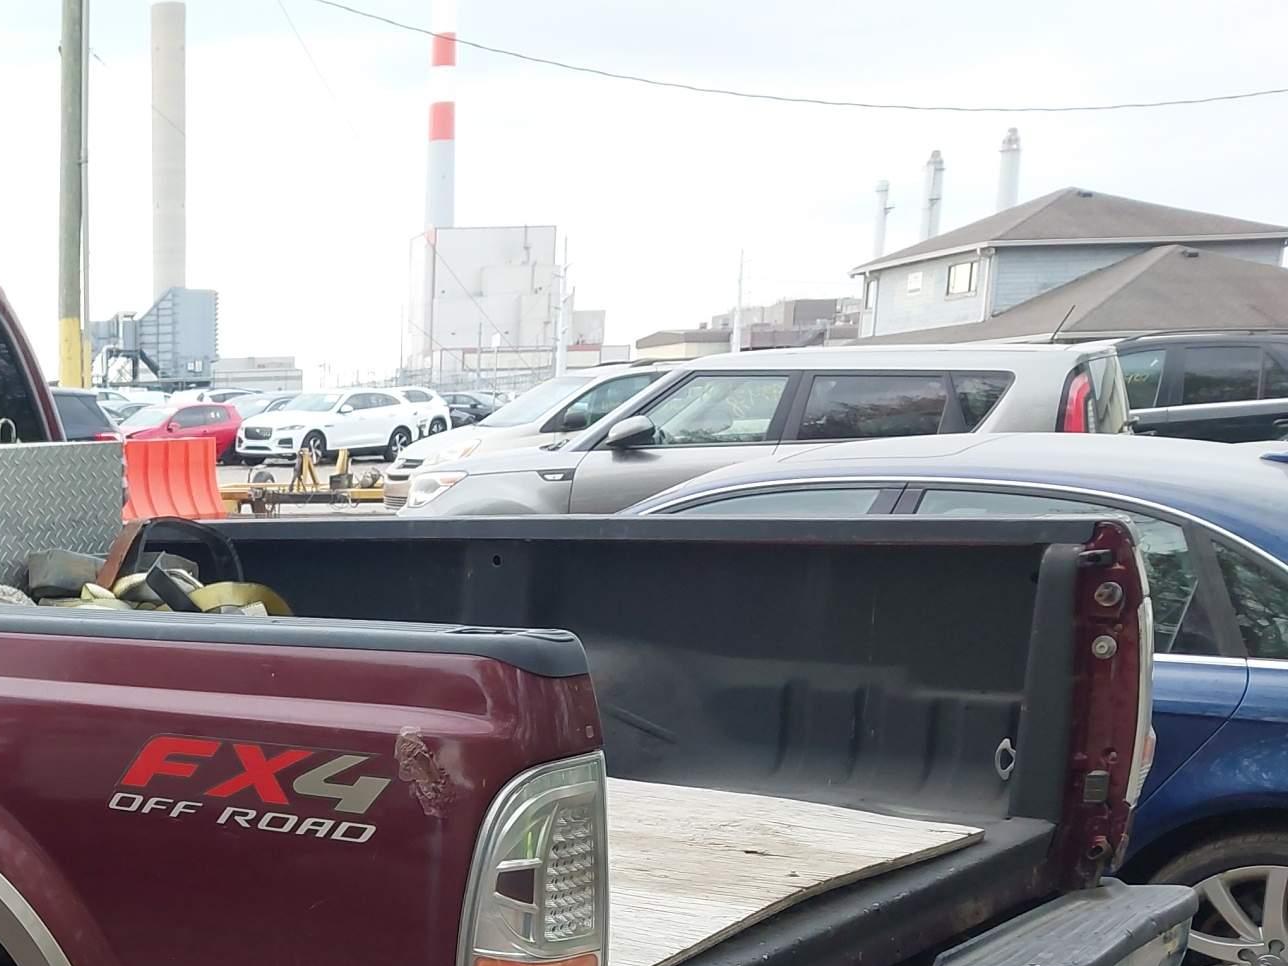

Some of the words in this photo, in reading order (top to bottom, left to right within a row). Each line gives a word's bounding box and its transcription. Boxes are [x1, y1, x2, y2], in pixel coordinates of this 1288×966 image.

[119, 736, 392, 814] FX4
[108, 792, 204, 818] OFF
[215, 806, 377, 843] ROAD
